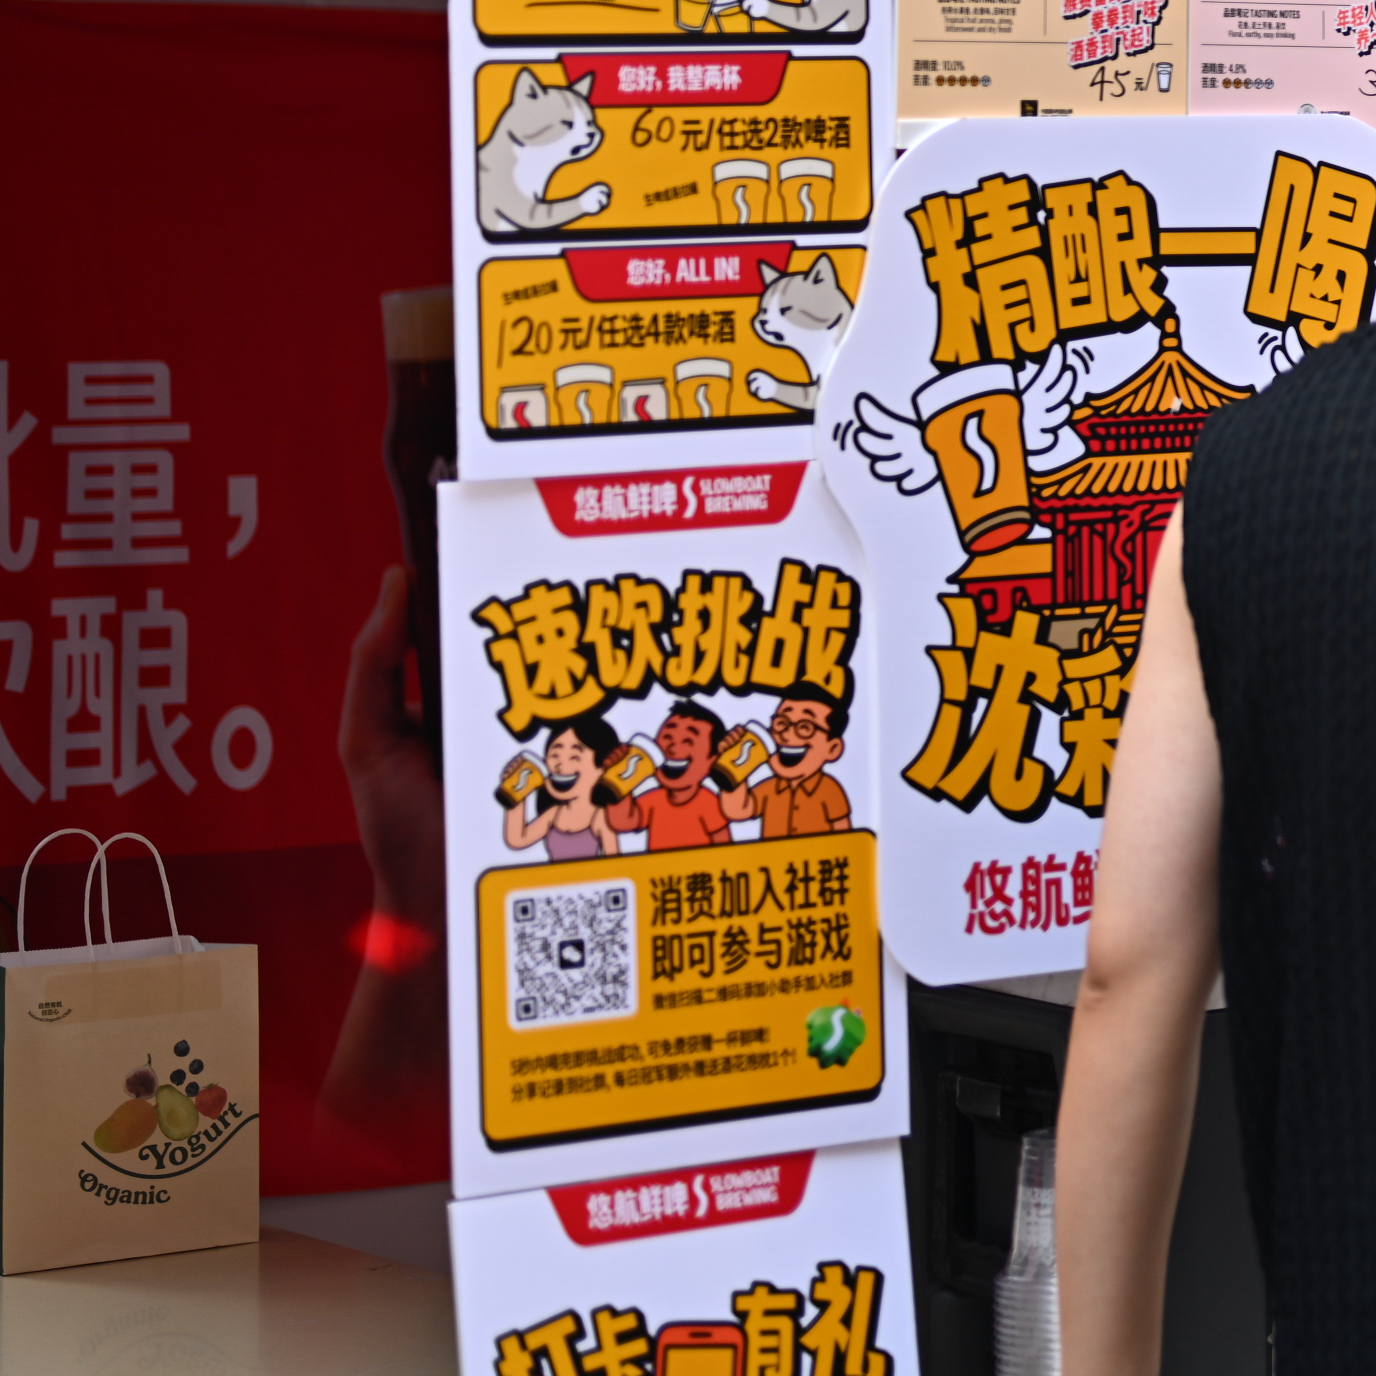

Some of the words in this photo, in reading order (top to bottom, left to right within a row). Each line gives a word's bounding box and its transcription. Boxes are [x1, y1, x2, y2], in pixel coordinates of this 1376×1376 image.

[676, 259, 711, 283] ALL
[714, 256, 741, 281] IN!
[472, 558, 860, 741] 速饮挑战
[650, 857, 850, 926] 消费加入社群
[651, 913, 852, 982] 即可参与游戏
[138, 1100, 243, 1170] Yogurt
[77, 1168, 171, 1207] Organic
